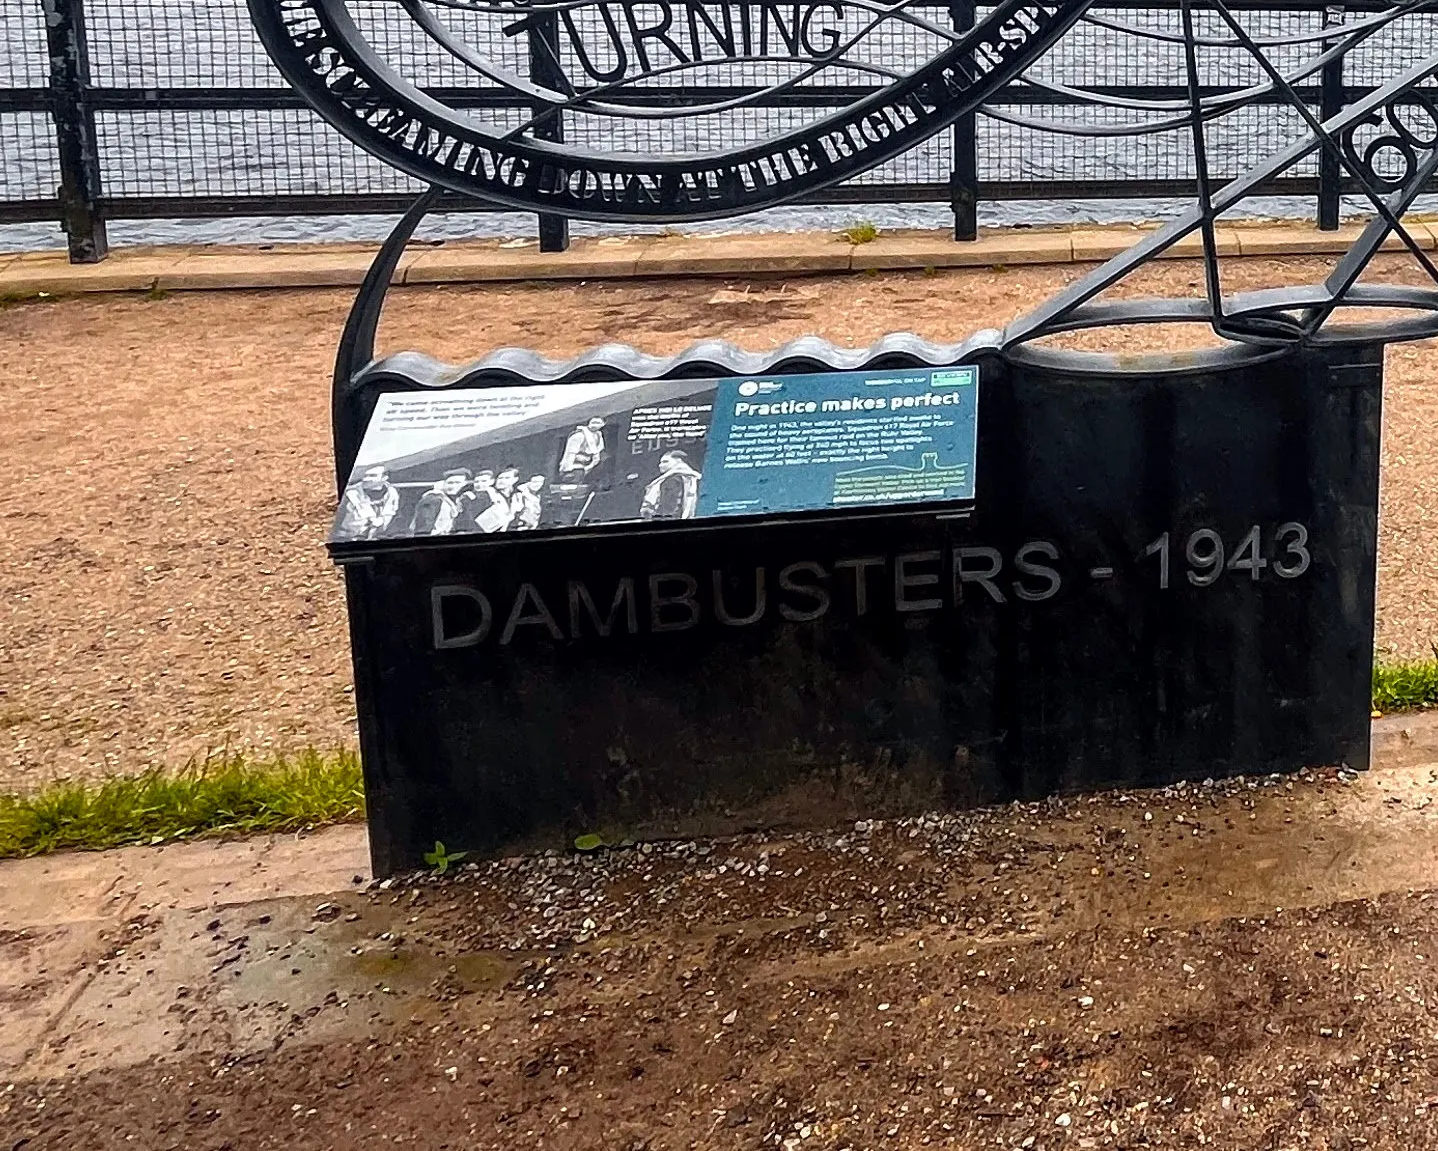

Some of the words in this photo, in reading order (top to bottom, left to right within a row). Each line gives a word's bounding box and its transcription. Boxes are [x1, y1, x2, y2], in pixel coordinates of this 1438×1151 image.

[305, 47, 530, 189] SCREAMING
[539, 162, 662, 204] DOWN
[678, 168, 724, 202] AT
[731, 143, 818, 192] THE
[818, 83, 936, 164] RIGHT
[735, 400, 816, 416] Practice
[821, 397, 886, 412] makes
[891, 391, 960, 410] perfect
[430, 541, 1064, 650] DAMBUSTERS
[1090, 566, 1115, 578] -
[1145, 521, 1311, 590] 1943
